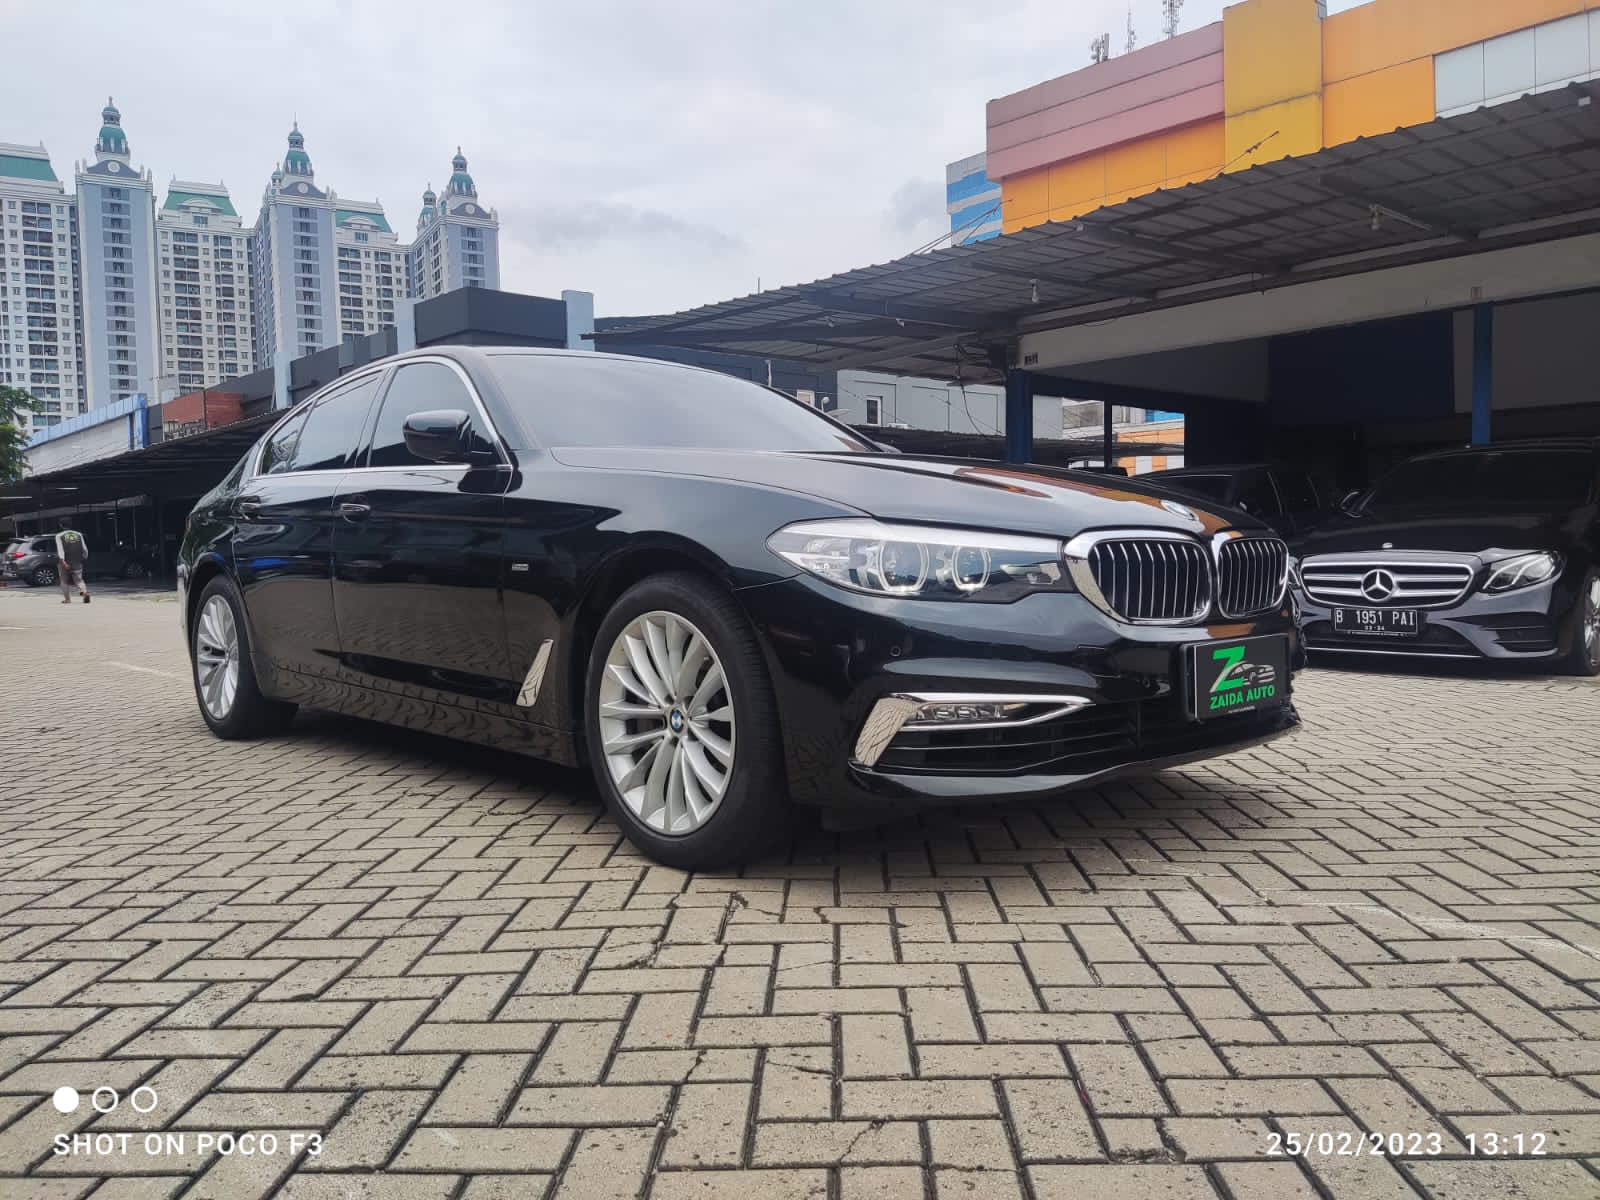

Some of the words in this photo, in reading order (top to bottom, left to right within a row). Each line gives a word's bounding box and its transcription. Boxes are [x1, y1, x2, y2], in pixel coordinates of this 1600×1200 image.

[1336, 609, 1344, 624] B
[1356, 610, 1383, 624] 1951
[1392, 611, 1415, 626] PAI
[1209, 645, 1246, 693] Z
[1209, 691, 1244, 710] ZAIDA
[1246, 684, 1275, 702] AUTO
